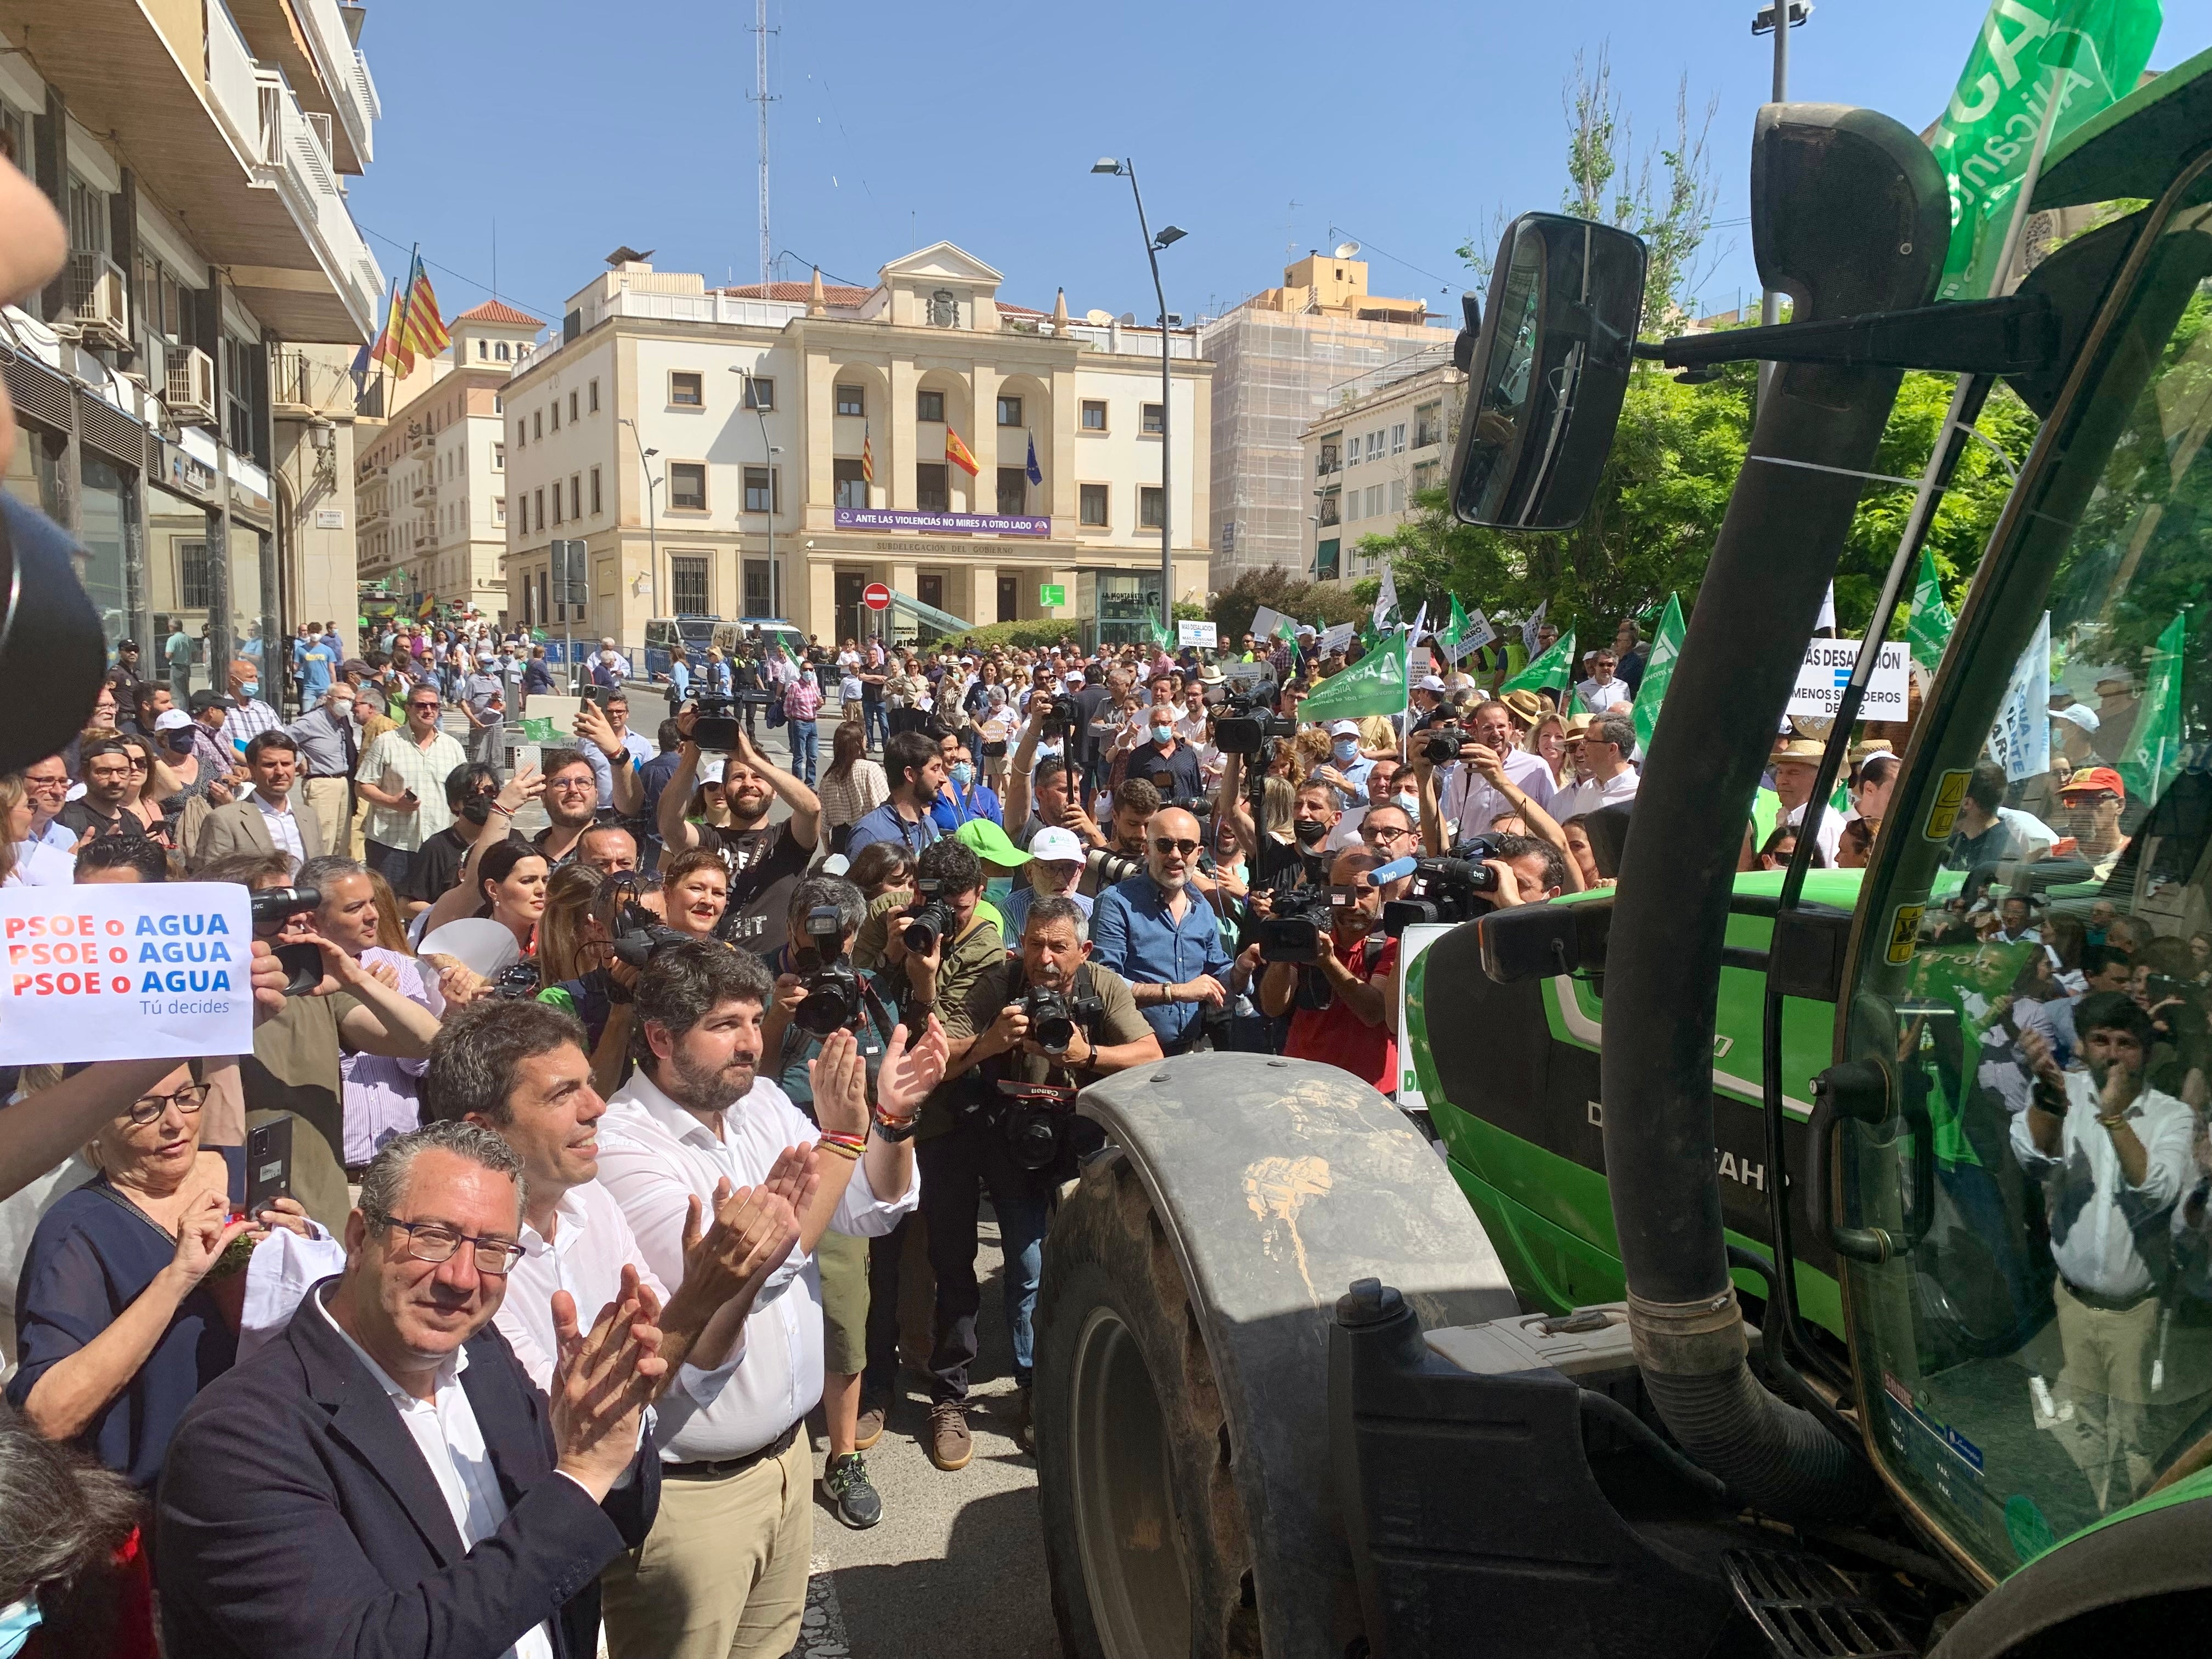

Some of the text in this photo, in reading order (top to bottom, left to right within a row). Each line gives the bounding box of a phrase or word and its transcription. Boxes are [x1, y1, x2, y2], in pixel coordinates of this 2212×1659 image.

[855, 514, 877, 523] ANTE
[878, 516, 893, 524] LAS
[895, 516, 940, 526] VIOLENCIAS
[943, 518, 954, 527] NO
[956, 518, 980, 528] MIRES
[981, 520, 988, 528] A
[989, 520, 1009, 529] OTRO
[1011, 521, 1031, 530] LADO
[973, 546, 1013, 554] GOBIERNO
[1460, 627, 1482, 642] PARO
[1460, 635, 1489, 654] TRASVASE
[1802, 644, 1821, 666] ÁS
[1791, 687, 1831, 700] MENOS
[1382, 871, 1397, 884] tve
[1473, 870, 1485, 879] tve
[5, 913, 229, 939] PSOE o AGUA
[8, 941, 232, 966] PSOE o AGUA
[12, 970, 231, 996] PSOE o AGUA
[140, 999, 229, 1015] Tú decides
[1031, 1088, 1059, 1097] Canon
